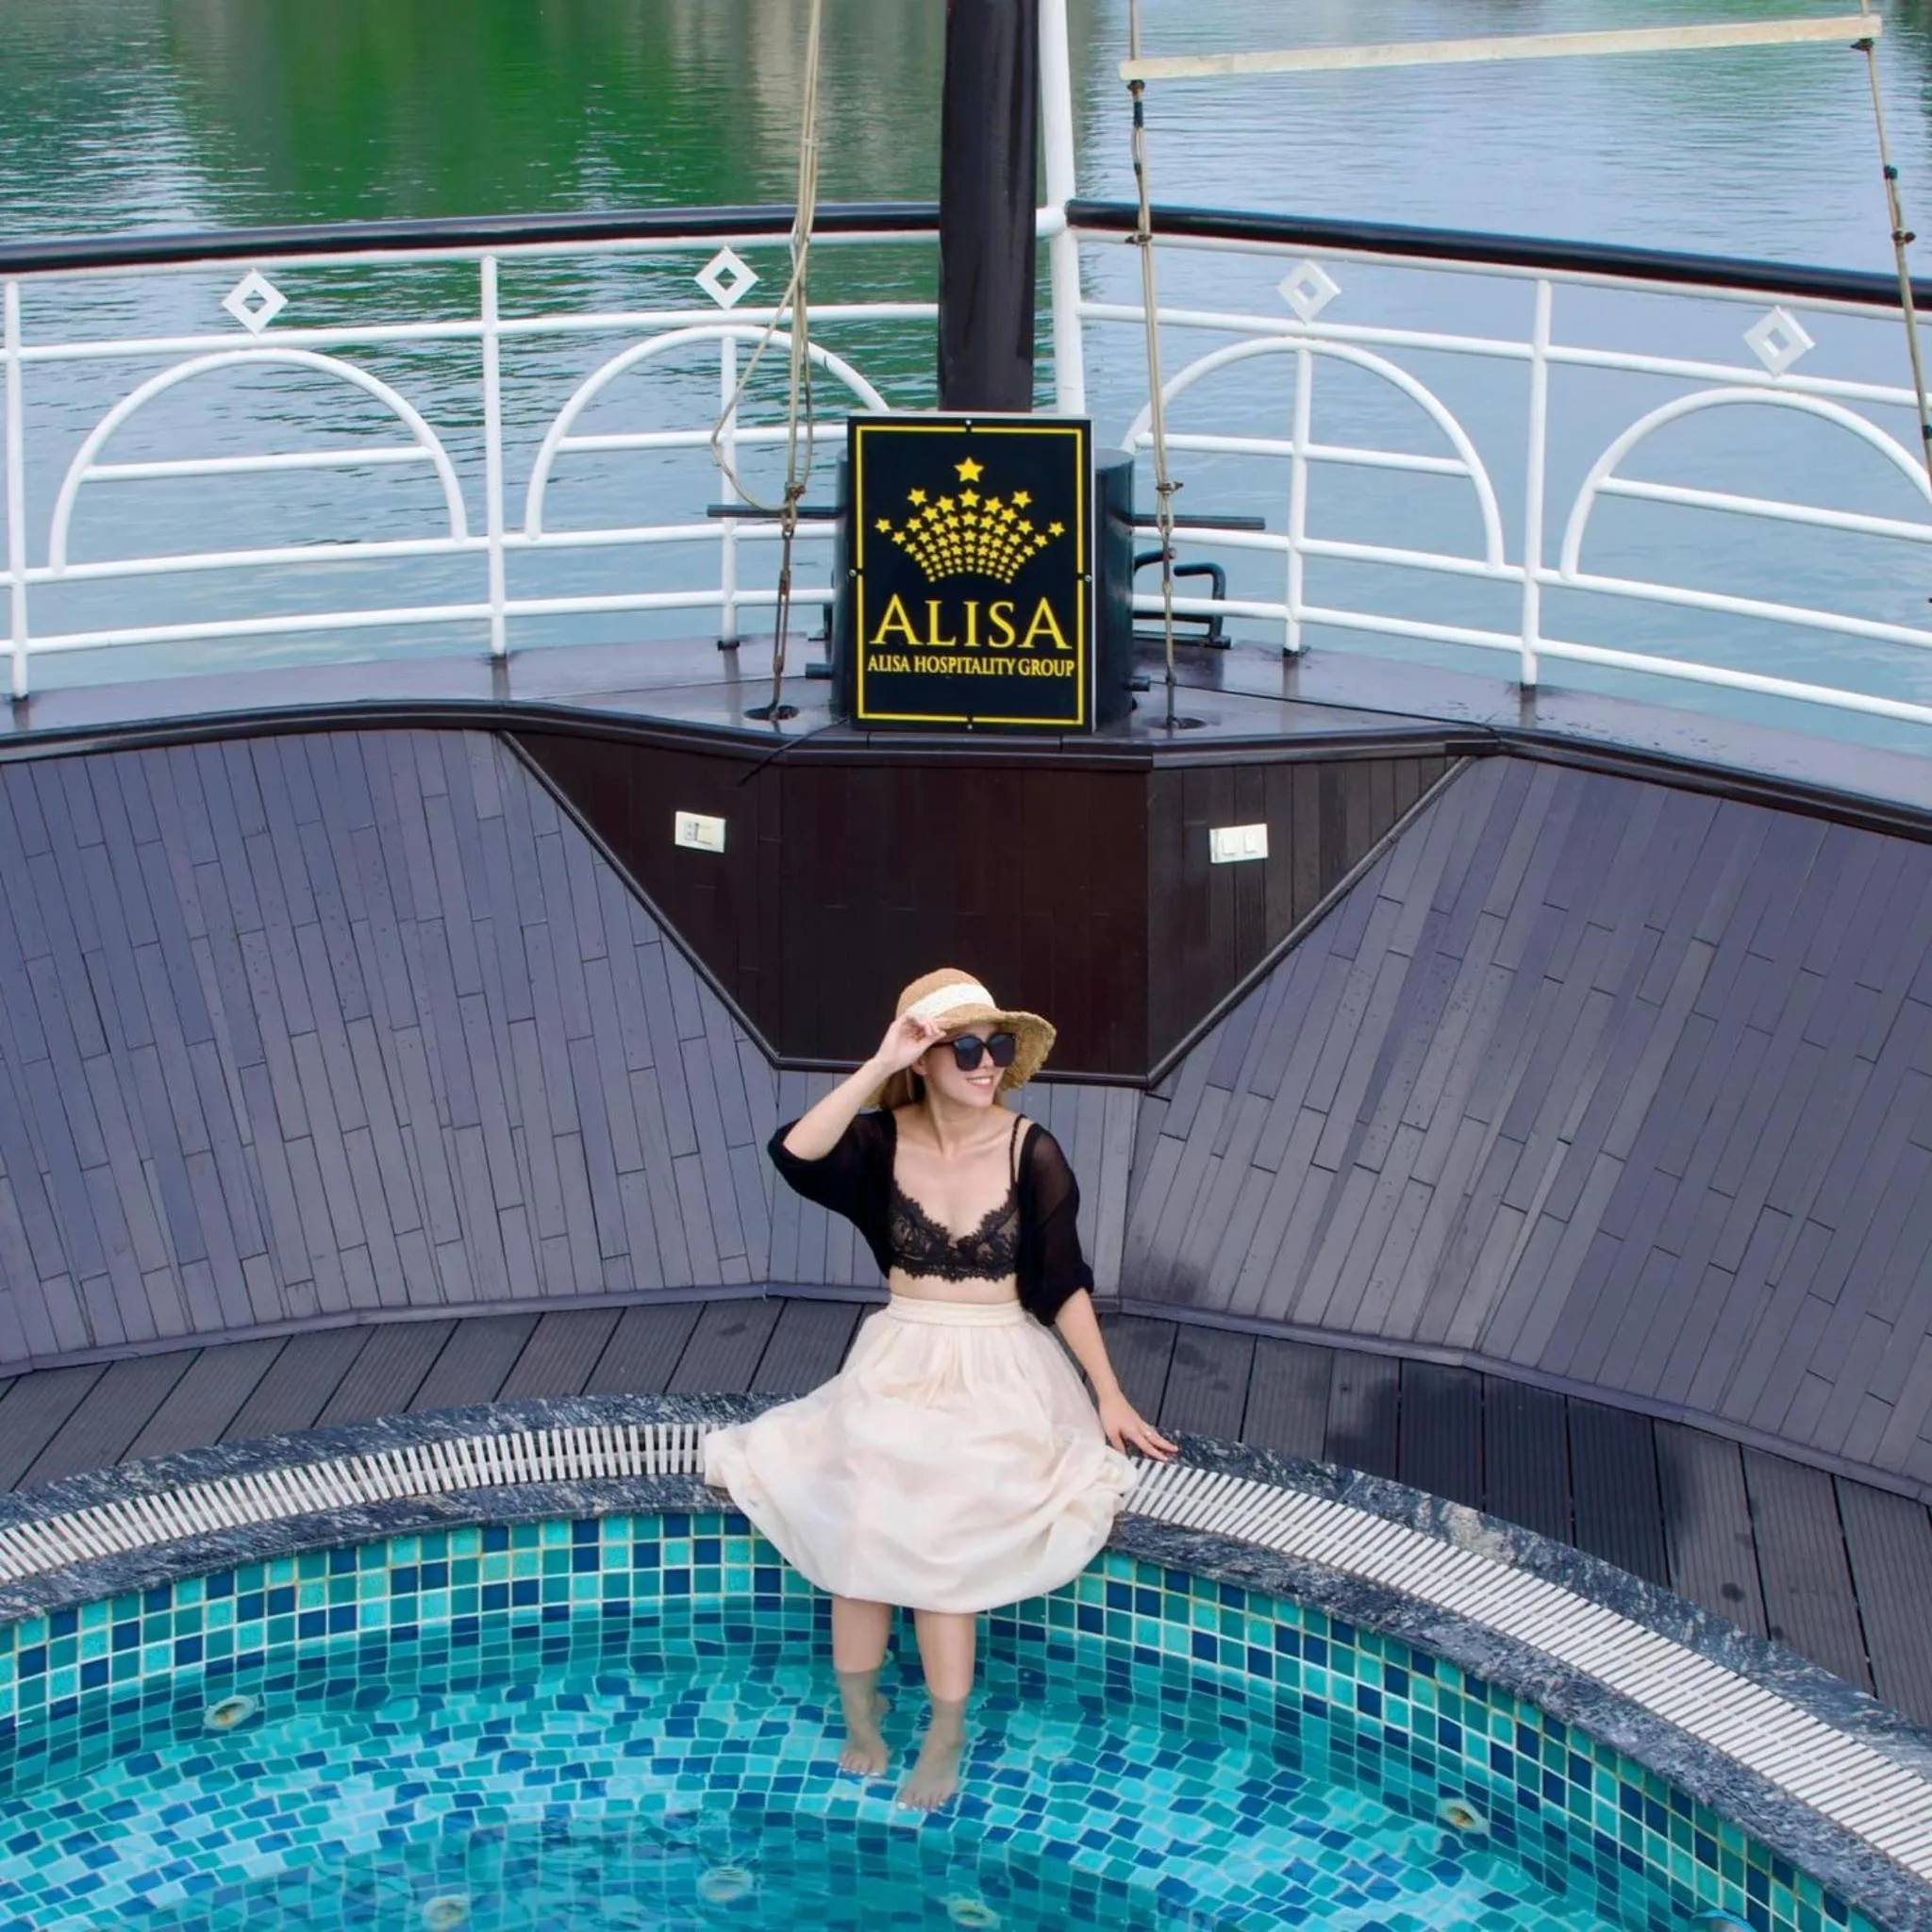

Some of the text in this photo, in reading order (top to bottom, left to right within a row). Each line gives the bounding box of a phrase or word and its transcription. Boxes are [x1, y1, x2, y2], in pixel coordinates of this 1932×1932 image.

[869, 593, 1073, 649] ALISA
[867, 655, 1074, 676] ALISA HOSPITALITY GROUP
